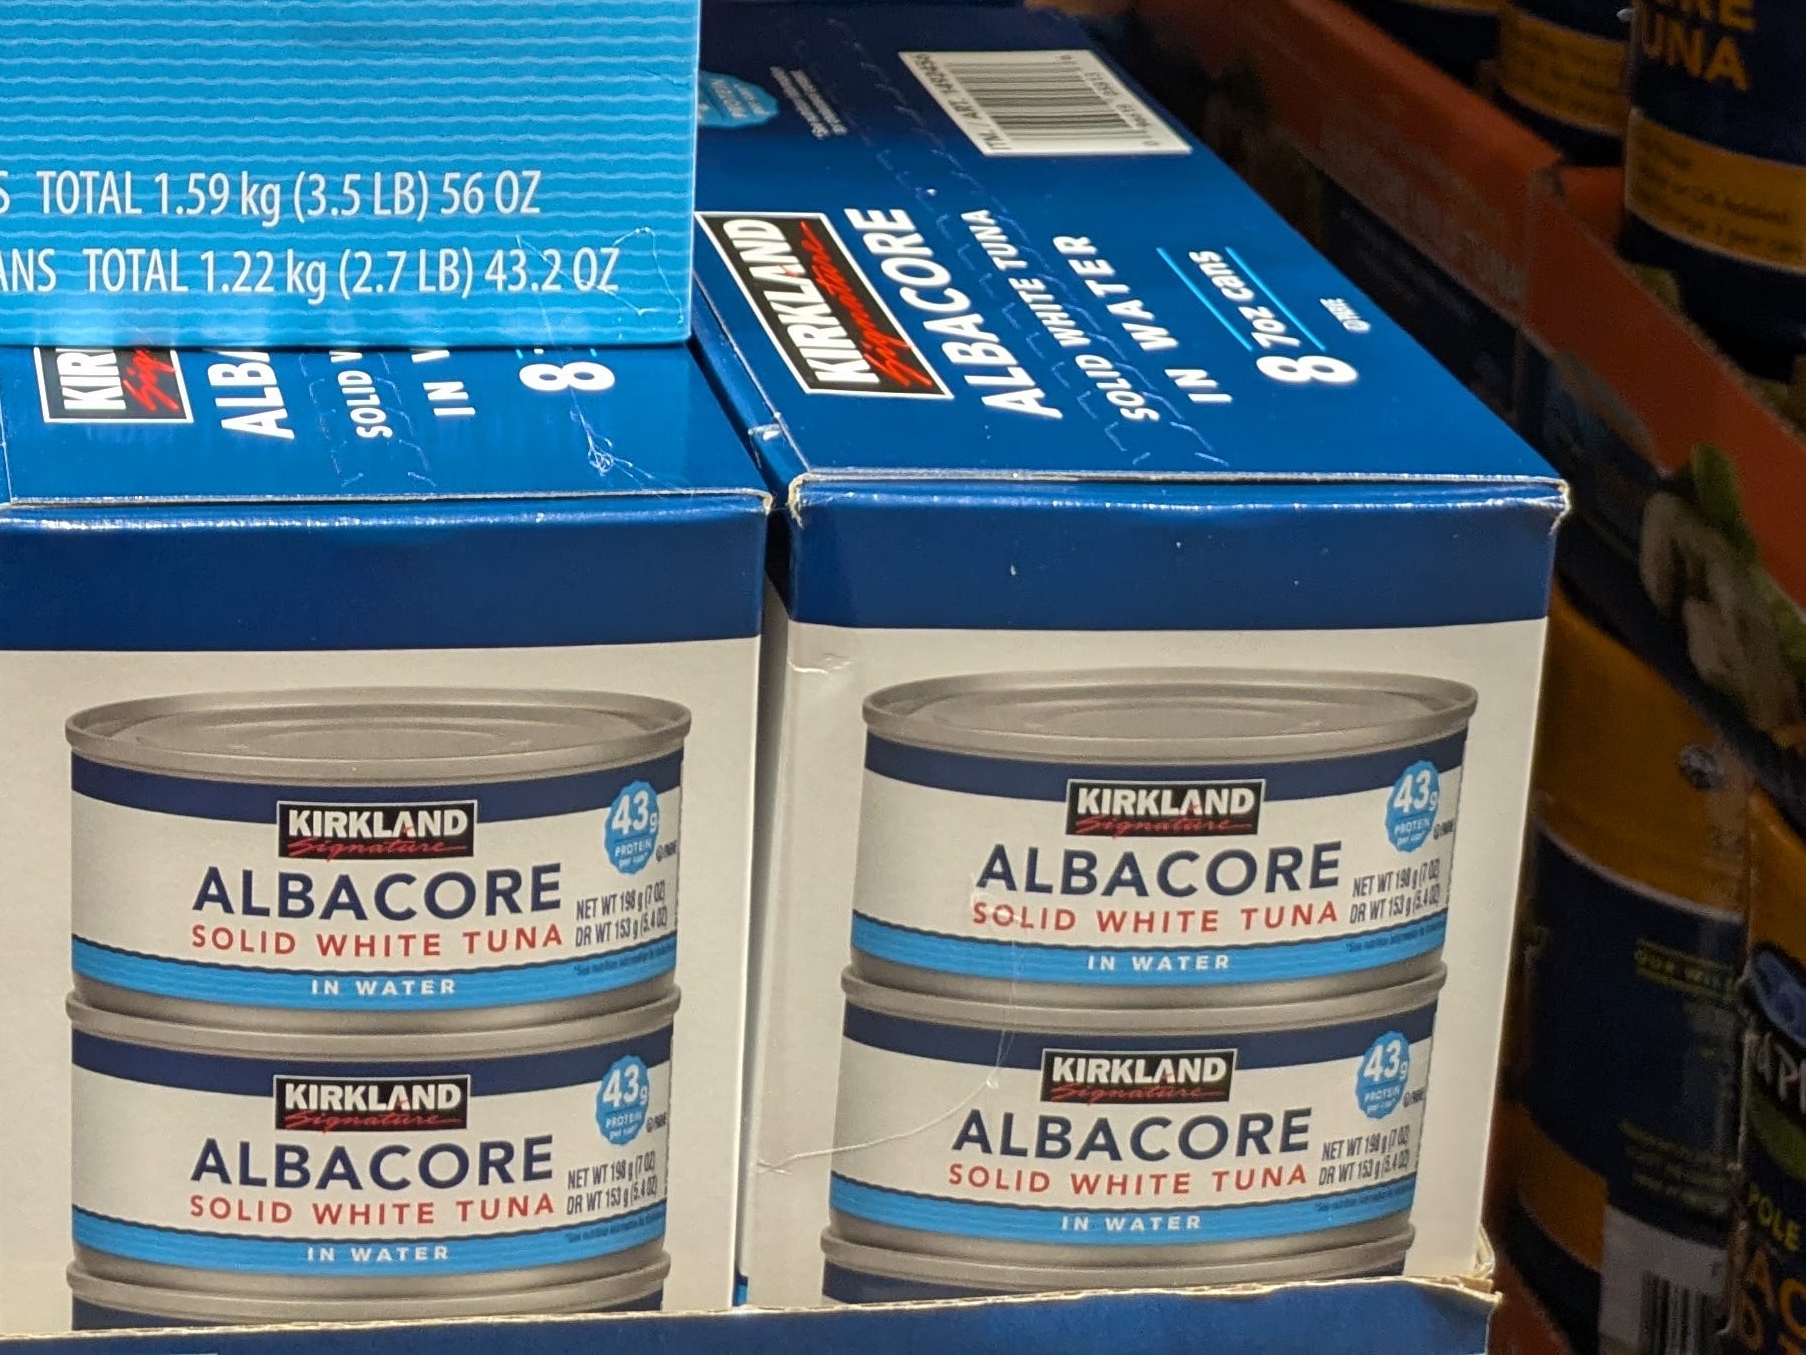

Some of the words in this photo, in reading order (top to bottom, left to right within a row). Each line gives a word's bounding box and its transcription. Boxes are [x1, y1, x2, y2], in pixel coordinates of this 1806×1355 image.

[36, 171, 142, 215] TOTAL
[154, 172, 230, 215] 1.59
[241, 171, 281, 227] kg
[293, 172, 362, 223] (3.5
[374, 171, 428, 221] LB)
[440, 172, 483, 214] 56
[494, 171, 542, 214] OZ
[959, 209, 1020, 271] TUNA
[82, 248, 188, 292] TOTAL
[199, 251, 275, 292] 1.22
[286, 248, 326, 304] kg
[339, 249, 406, 301] (2.7
[417, 248, 472, 299] LB)
[484, 249, 562, 292] 43.2
[572, 248, 618, 292] OZ
[722, 218, 881, 386] KIRKLAND
[1052, 235, 1179, 351] WATER
[1188, 251, 1256, 303] cans
[844, 207, 1063, 420] ALBACORE
[1008, 277, 1093, 348] WHITE
[1247, 304, 1303, 350] 7oz
[1075, 356, 1160, 423] SOLID
[1164, 367, 1234, 405] IN
[1255, 356, 1361, 386] 8
[288, 808, 468, 839] KIRKLAND
[1077, 788, 1255, 818] KIRKLAND
[193, 864, 562, 921] ALBACORE
[975, 841, 1342, 898] ALBACORE
[192, 924, 296, 955] SOLID
[316, 933, 442, 958] WHITE
[463, 923, 563, 954] TUNA
[284, 1083, 462, 1111] KIRKLAND
[1052, 1057, 1228, 1086] KIRKLAND
[190, 1134, 554, 1191] ALBACORE
[952, 1107, 1313, 1162] ALBACORE
